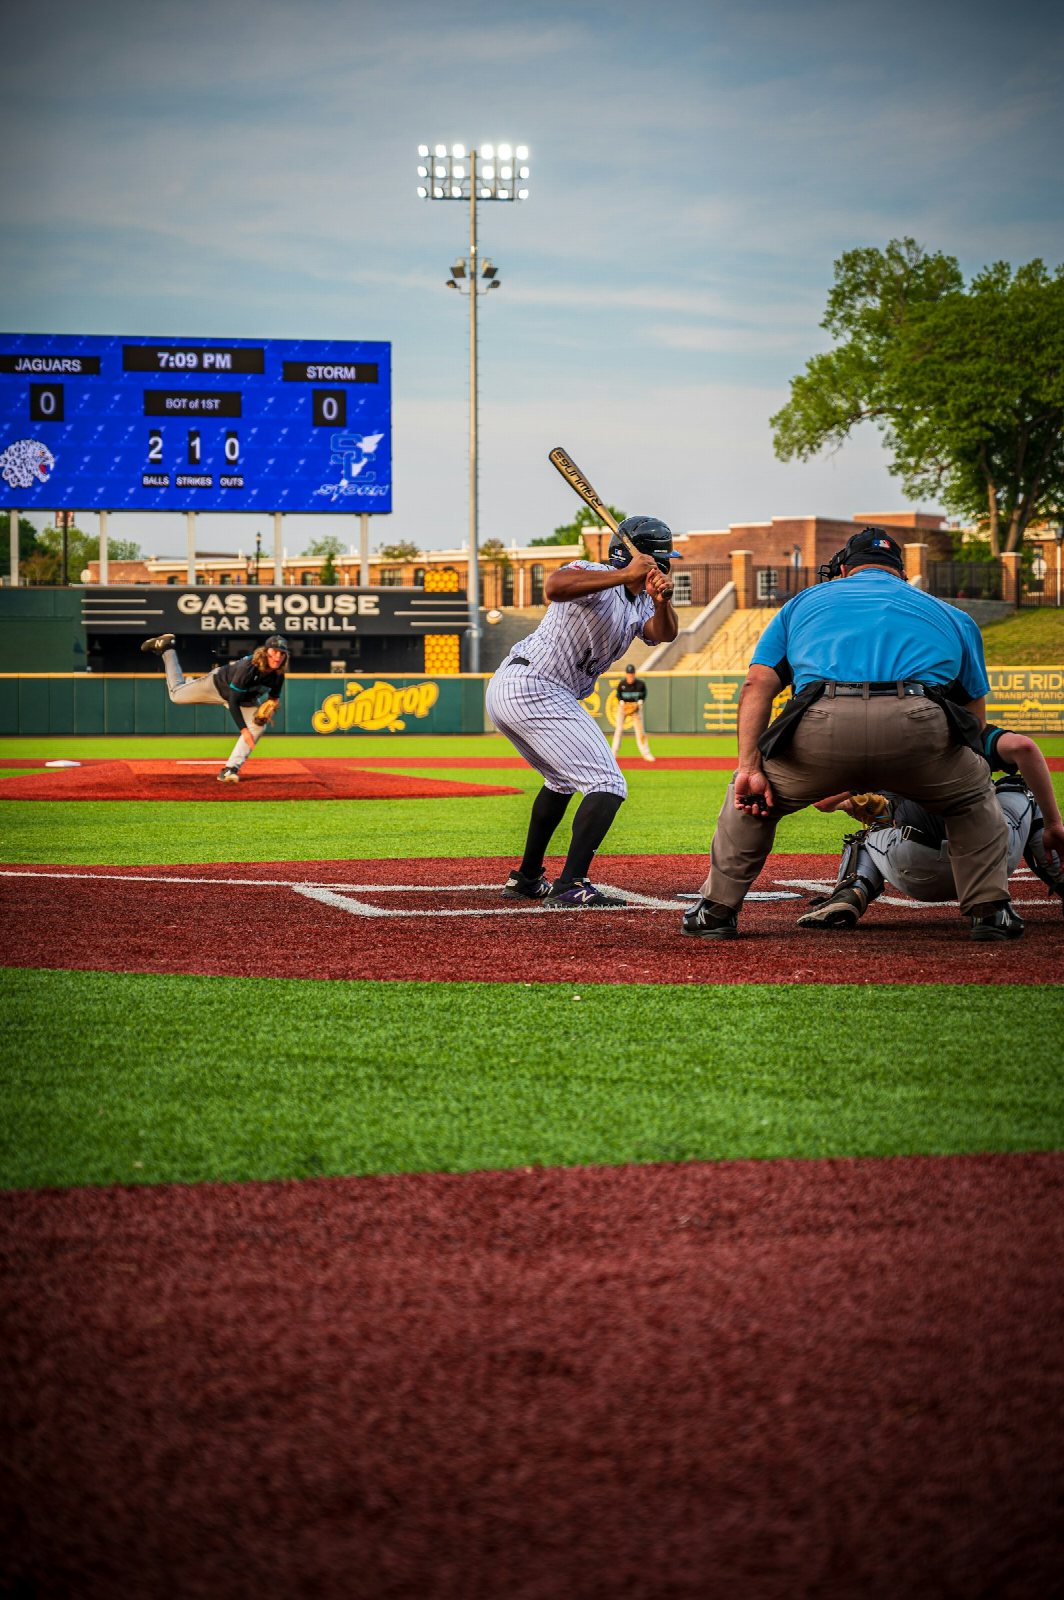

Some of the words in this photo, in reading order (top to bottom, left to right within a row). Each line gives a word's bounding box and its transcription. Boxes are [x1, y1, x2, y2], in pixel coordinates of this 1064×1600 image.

[14, 358, 82, 372] JAGUARS
[157, 352, 198, 368] 7:09
[203, 353, 232, 369] PM
[306, 365, 356, 380] STORM
[39, 391, 56, 415] 0
[165, 398, 187, 409] BOT
[188, 399, 199, 410] of
[200, 399, 221, 410] 1ST
[322, 397, 338, 421] 0
[148, 436, 163, 459] 2
[190, 437, 201, 460] 1
[224, 437, 240, 461] 0
[142, 475, 170, 486] BALLS
[175, 476, 213, 487] STRIKES
[219, 477, 244, 487] OUTS
[177, 593, 249, 615] GAS
[258, 594, 381, 615] HOUSE
[201, 616, 250, 631] BAR
[258, 616, 277, 631] &
[284, 616, 357, 631] GRILL
[989, 673, 1026, 691] LUE
[1029, 673, 1064, 691] RID
